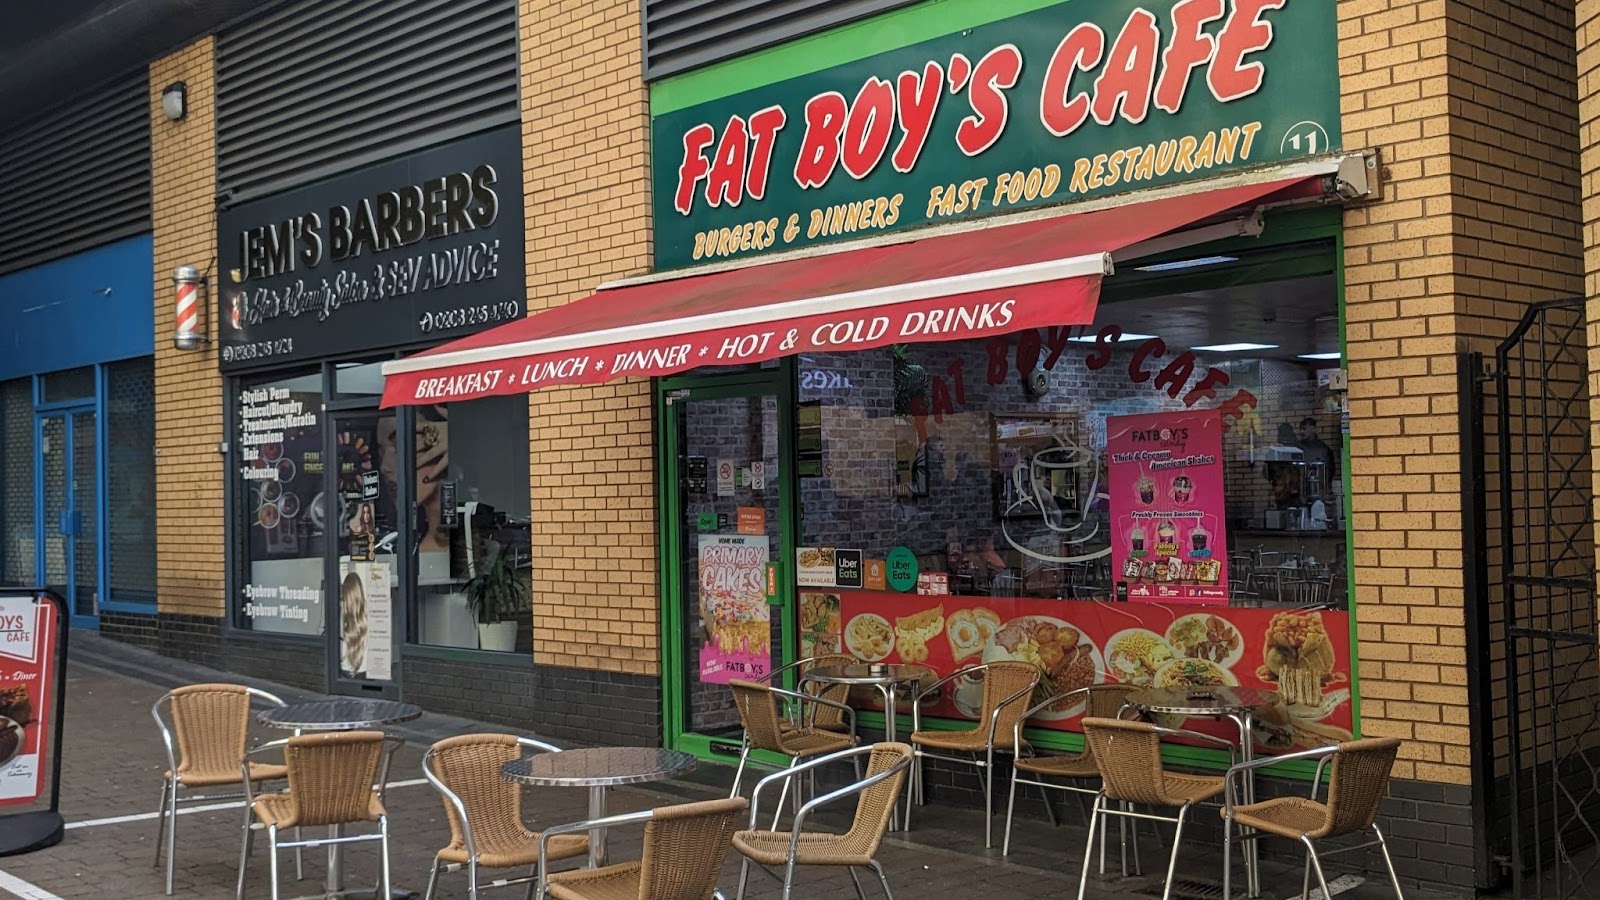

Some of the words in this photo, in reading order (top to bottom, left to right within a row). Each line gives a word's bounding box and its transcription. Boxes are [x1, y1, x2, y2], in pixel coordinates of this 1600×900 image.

[674, 104, 787, 217] FAT
[793, 43, 1023, 190] BOY'S
[1040, 0, 1287, 138] CAFE
[1288, 130, 1317, 154] 11
[693, 217, 779, 260] BURGERS
[783, 213, 800, 244] &
[807, 193, 904, 238] DINNERS
[926, 178, 988, 219] FAST
[992, 163, 1061, 206] FOOD
[1069, 121, 1262, 194] RESTAURANT
[230, 211, 323, 284] JEM'S
[329, 164, 498, 261] BARBERS
[423, 239, 500, 290] ADVICE
[414, 369, 503, 399] BREAKFAST
[521, 357, 589, 385] LUNCH
[610, 344, 692, 375] DINNER
[717, 332, 774, 359] HOT
[779, 328, 799, 351] &
[810, 316, 890, 346] COLD
[900, 300, 1016, 336] DRINKS
[242, 388, 268, 405] Stylish
[270, 386, 290, 400] Perm
[243, 431, 284, 446] Extensions
[1132, 427, 1189, 442] FATBOY'S
[243, 448, 260, 461] Hair
[1112, 451, 1133, 463] Thick
[1150, 459, 1187, 471] American
[1187, 454, 1215, 466] Shakes
[243, 466, 279, 482] Colouring
[1131, 511, 1153, 519] Freshly
[1173, 510, 1204, 518] Smoothies
[703, 545, 765, 566] PRIMARY
[838, 557, 858, 568] Uber
[892, 560, 911, 571] Uber
[702, 565, 762, 594] CAKES
[838, 568, 858, 580] Eats
[892, 570, 911, 581] Eats
[245, 584, 278, 601] Eyebrow
[279, 586, 320, 603] Threading
[246, 603, 278, 619] Eyebrow
[280, 604, 308, 622] Tinting
[7, 631, 30, 643] CAFE
[12, 670, 38, 681] Diner
